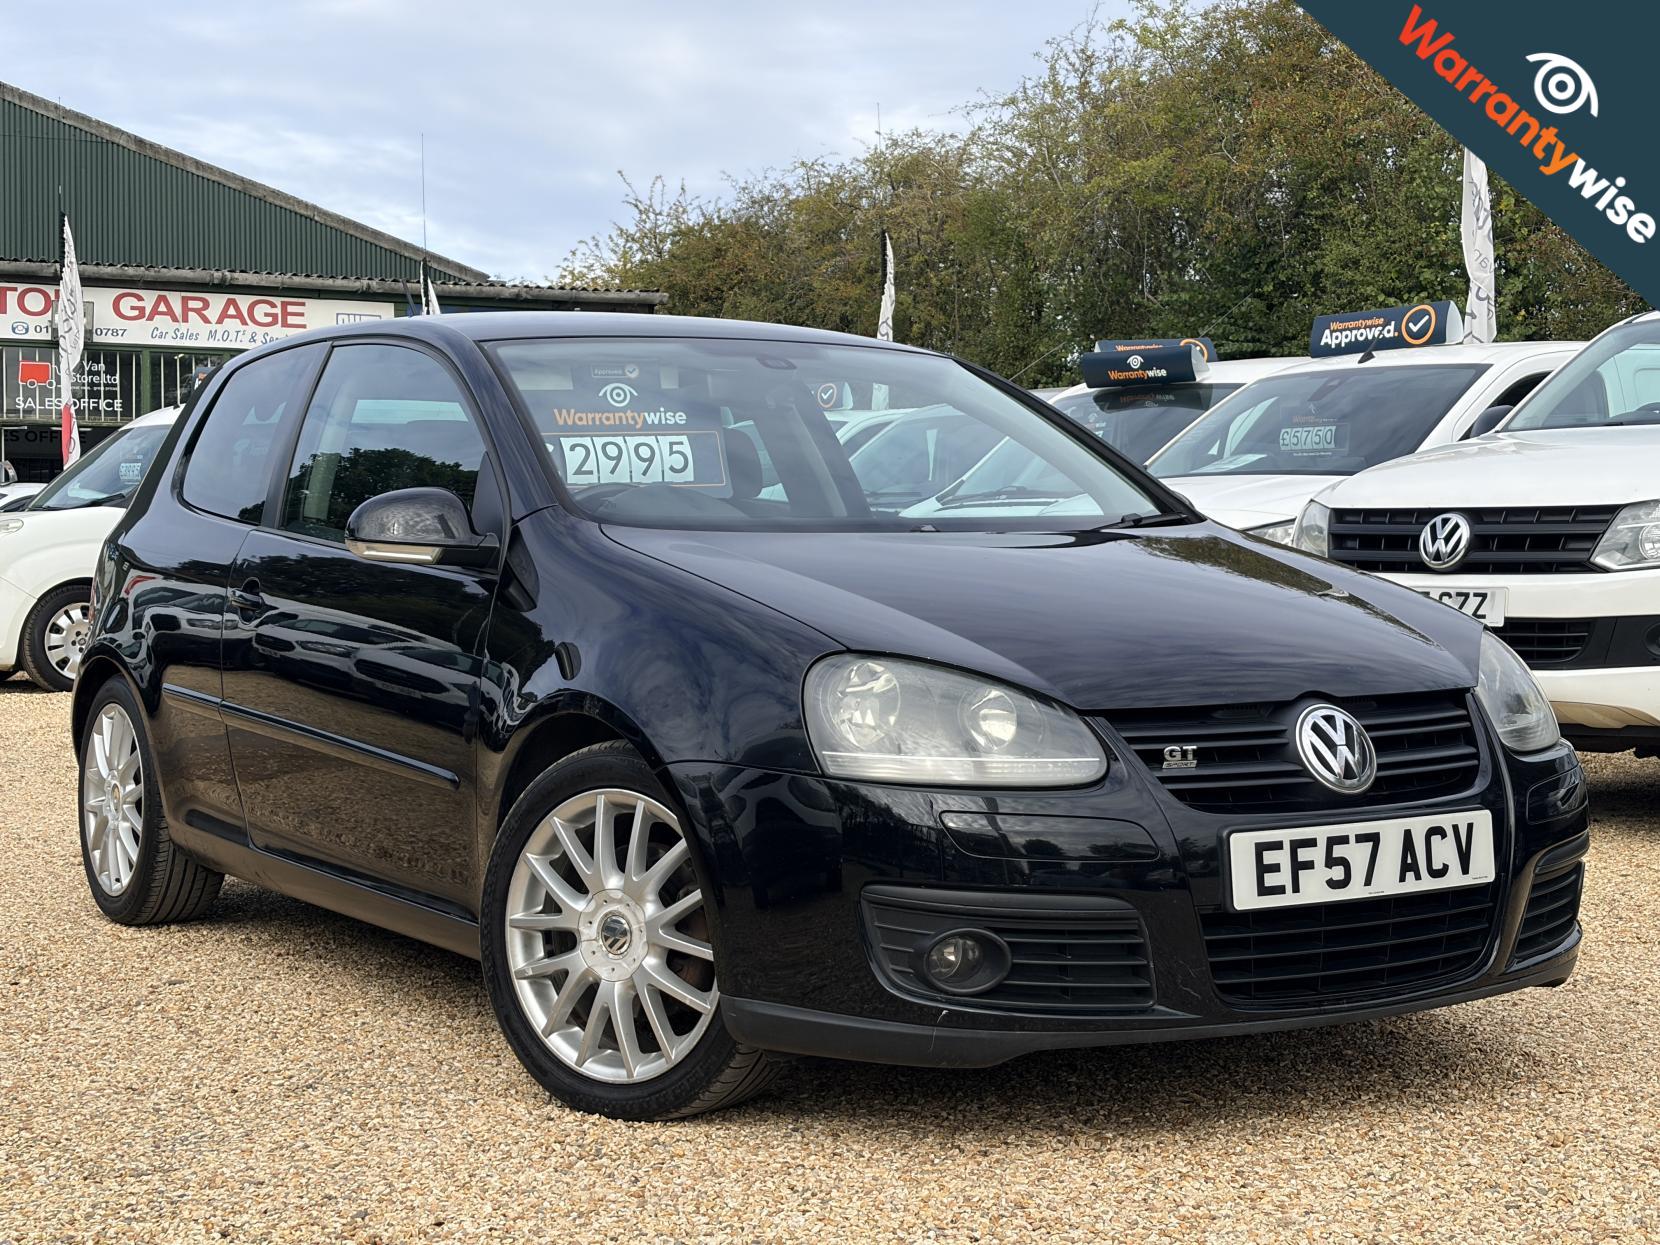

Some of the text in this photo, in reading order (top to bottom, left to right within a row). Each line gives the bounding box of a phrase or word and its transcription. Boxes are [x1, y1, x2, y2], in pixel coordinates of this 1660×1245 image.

[112, 291, 307, 329] GARAGE
[1330, 317, 1384, 331] Warrantywise
[151, 326, 169, 339] Car
[171, 328, 199, 341] Sales
[249, 331, 257, 343] &
[83, 360, 106, 372] Van
[1108, 367, 1167, 380] Warrantywise
[15, 397, 123, 410] SALES OFFICE
[553, 407, 688, 429] Warrantywise
[1281, 428, 1333, 446] £5750
[1164, 745, 1198, 761] GT
[1254, 822, 1474, 897] EF57 ACV
